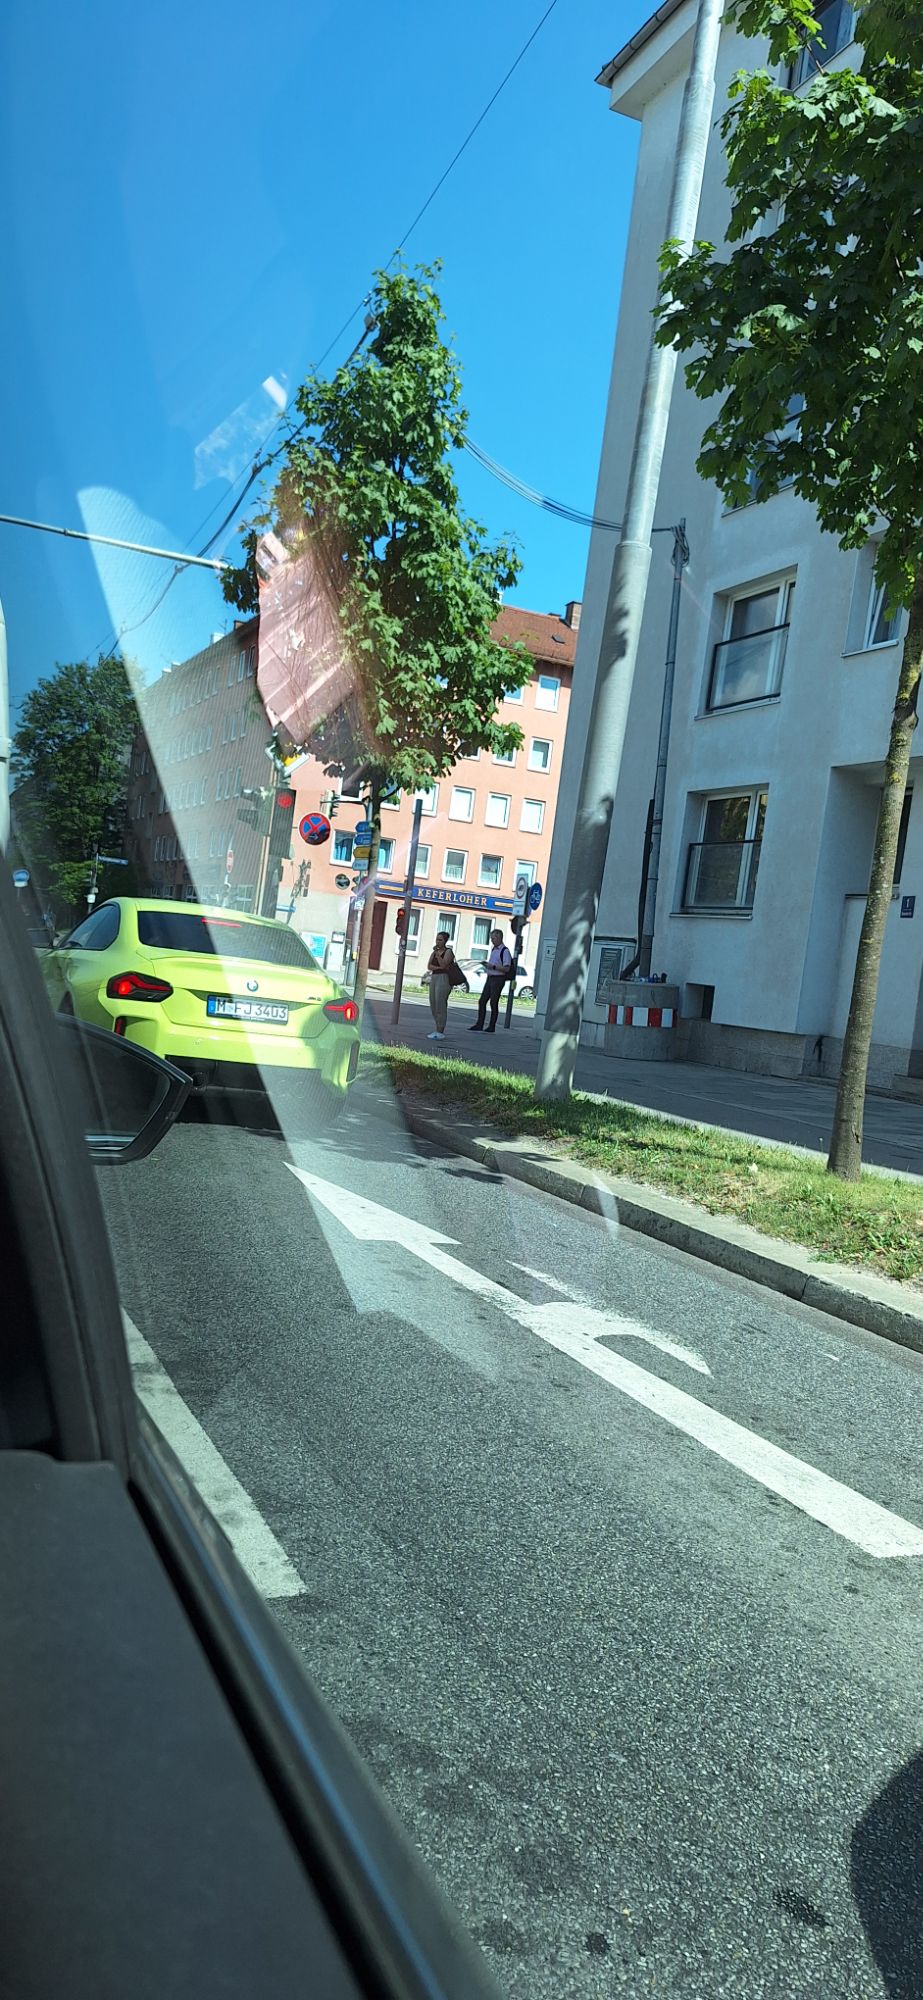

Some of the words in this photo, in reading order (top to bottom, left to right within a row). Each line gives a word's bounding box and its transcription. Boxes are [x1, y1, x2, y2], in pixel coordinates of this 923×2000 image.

[418, 888, 487, 906] KEFERLOHER
[217, 999, 226, 1012] M
[255, 1004, 286, 1018] 3403
